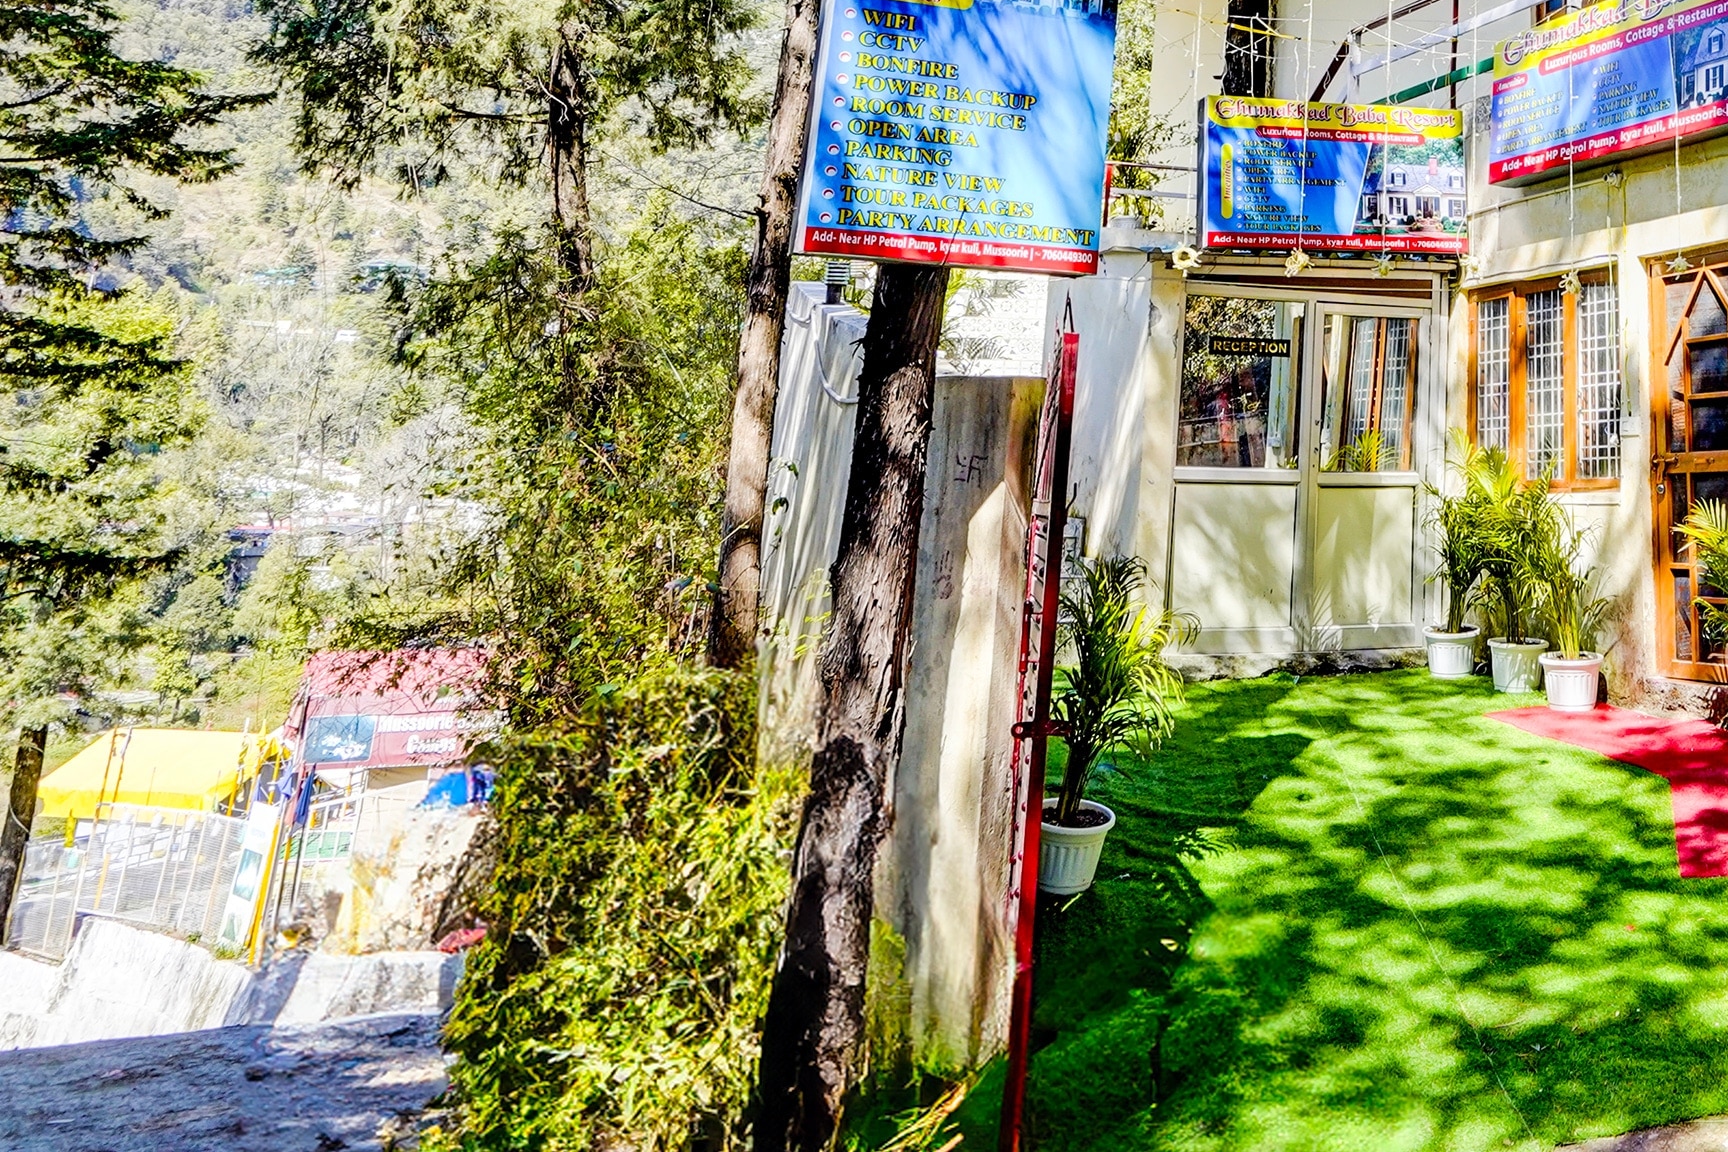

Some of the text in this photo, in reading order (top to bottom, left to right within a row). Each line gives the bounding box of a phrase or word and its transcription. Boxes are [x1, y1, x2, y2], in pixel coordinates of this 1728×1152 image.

[863, 9, 917, 32] WIFI
[859, 32, 925, 53] CCTV
[1545, 49, 1588, 70] Luxurious
[1589, 37, 1623, 56] Rooms,
[1625, 24, 1664, 43] Cottage
[1667, 19, 1675, 29] &
[855, 52, 960, 80] BONFIRE
[1599, 61, 1620, 74] WIFI
[853, 74, 1037, 111] POWER BACKUP
[1504, 88, 1536, 104] BONFIRE
[1598, 82, 1637, 101] PARKING
[850, 96, 1027, 132] ROOM SERVICE
[1215, 97, 1456, 133] Ghumakkad Baba Resort
[1503, 101, 1531, 117] POWER
[847, 118, 979, 148] OPEN AREA
[1262, 127, 1302, 137] Luxurious
[1335, 131, 1367, 141] Cottage
[1368, 133, 1375, 141] &
[1376, 133, 1419, 143] Restaurant
[1502, 161, 1522, 173] Add-
[1524, 153, 1545, 167] Near
[1546, 149, 1558, 162] HP
[1560, 140, 1587, 158] Petrol
[1588, 136, 1618, 153] Pump,
[1620, 128, 1642, 145] kyar
[1643, 120, 1667, 136] kuli,
[1668, 107, 1723, 129] Mussoorie
[845, 140, 952, 168] PARKING
[842, 163, 1006, 194] NATURE VIEW
[841, 184, 1035, 219] TOUR PACKAGES
[837, 208, 1095, 247] PARTY ARRANGEMENT
[812, 230, 1093, 264] Add- Near HP Petrol Pump, kyar kuli, Mussoorie 7060449300
[1213, 235, 1235, 244] Add-
[1237, 235, 1257, 244] Near
[1258, 236, 1270, 244] HP
[1272, 237, 1297, 245] Petrol
[1299, 238, 1325, 247] Pump,
[1326, 238, 1344, 248] kyar
[1345, 239, 1363, 248] kuli,
[1365, 239, 1405, 249] Mussoorie
[1213, 340, 1288, 353] RECEPTION
